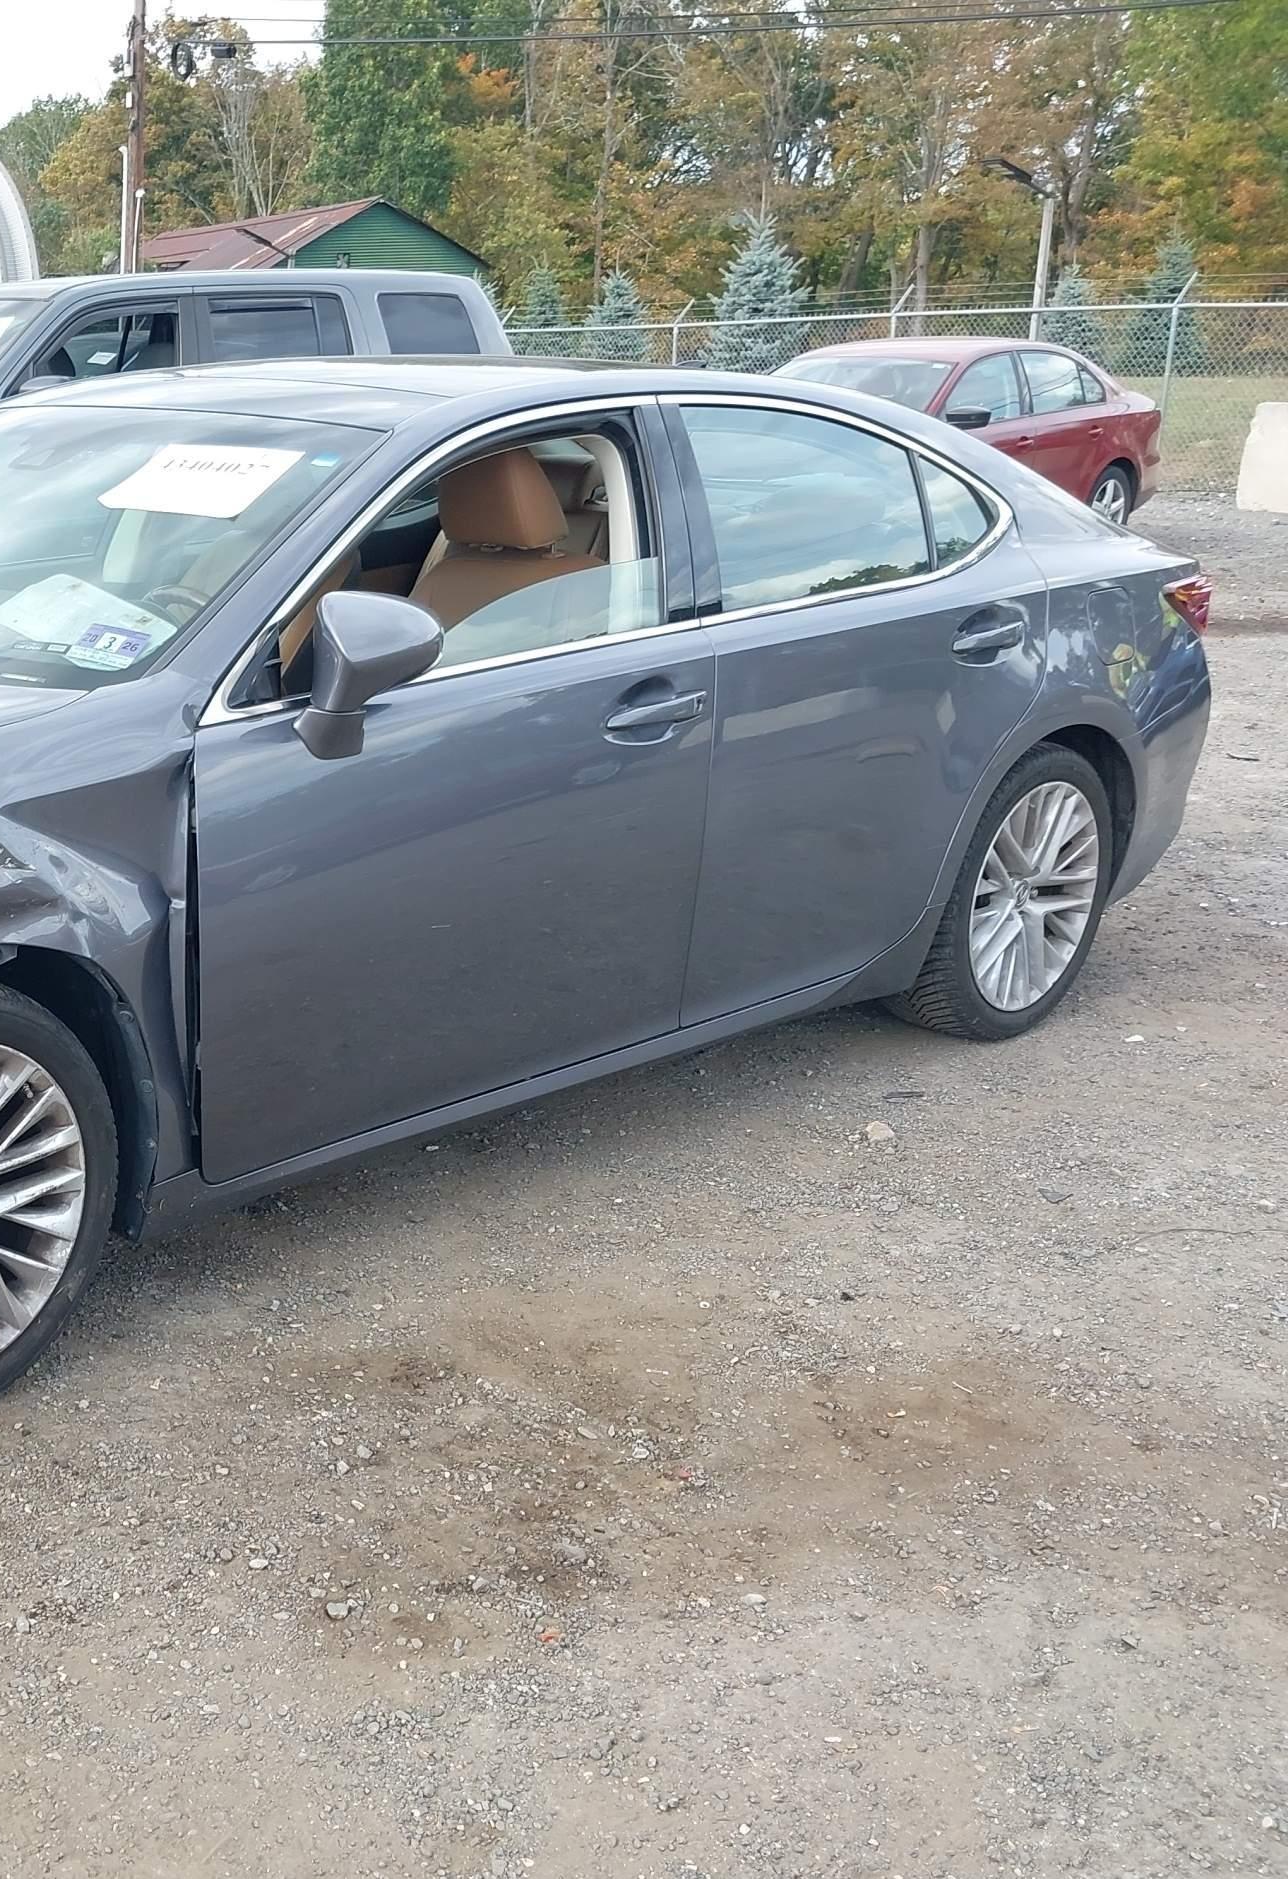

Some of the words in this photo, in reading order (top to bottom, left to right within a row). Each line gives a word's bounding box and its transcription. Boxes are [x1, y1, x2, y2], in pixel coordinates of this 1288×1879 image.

[82, 633, 99, 643] 20
[103, 636, 117, 649] 3
[122, 641, 140, 652] 26
